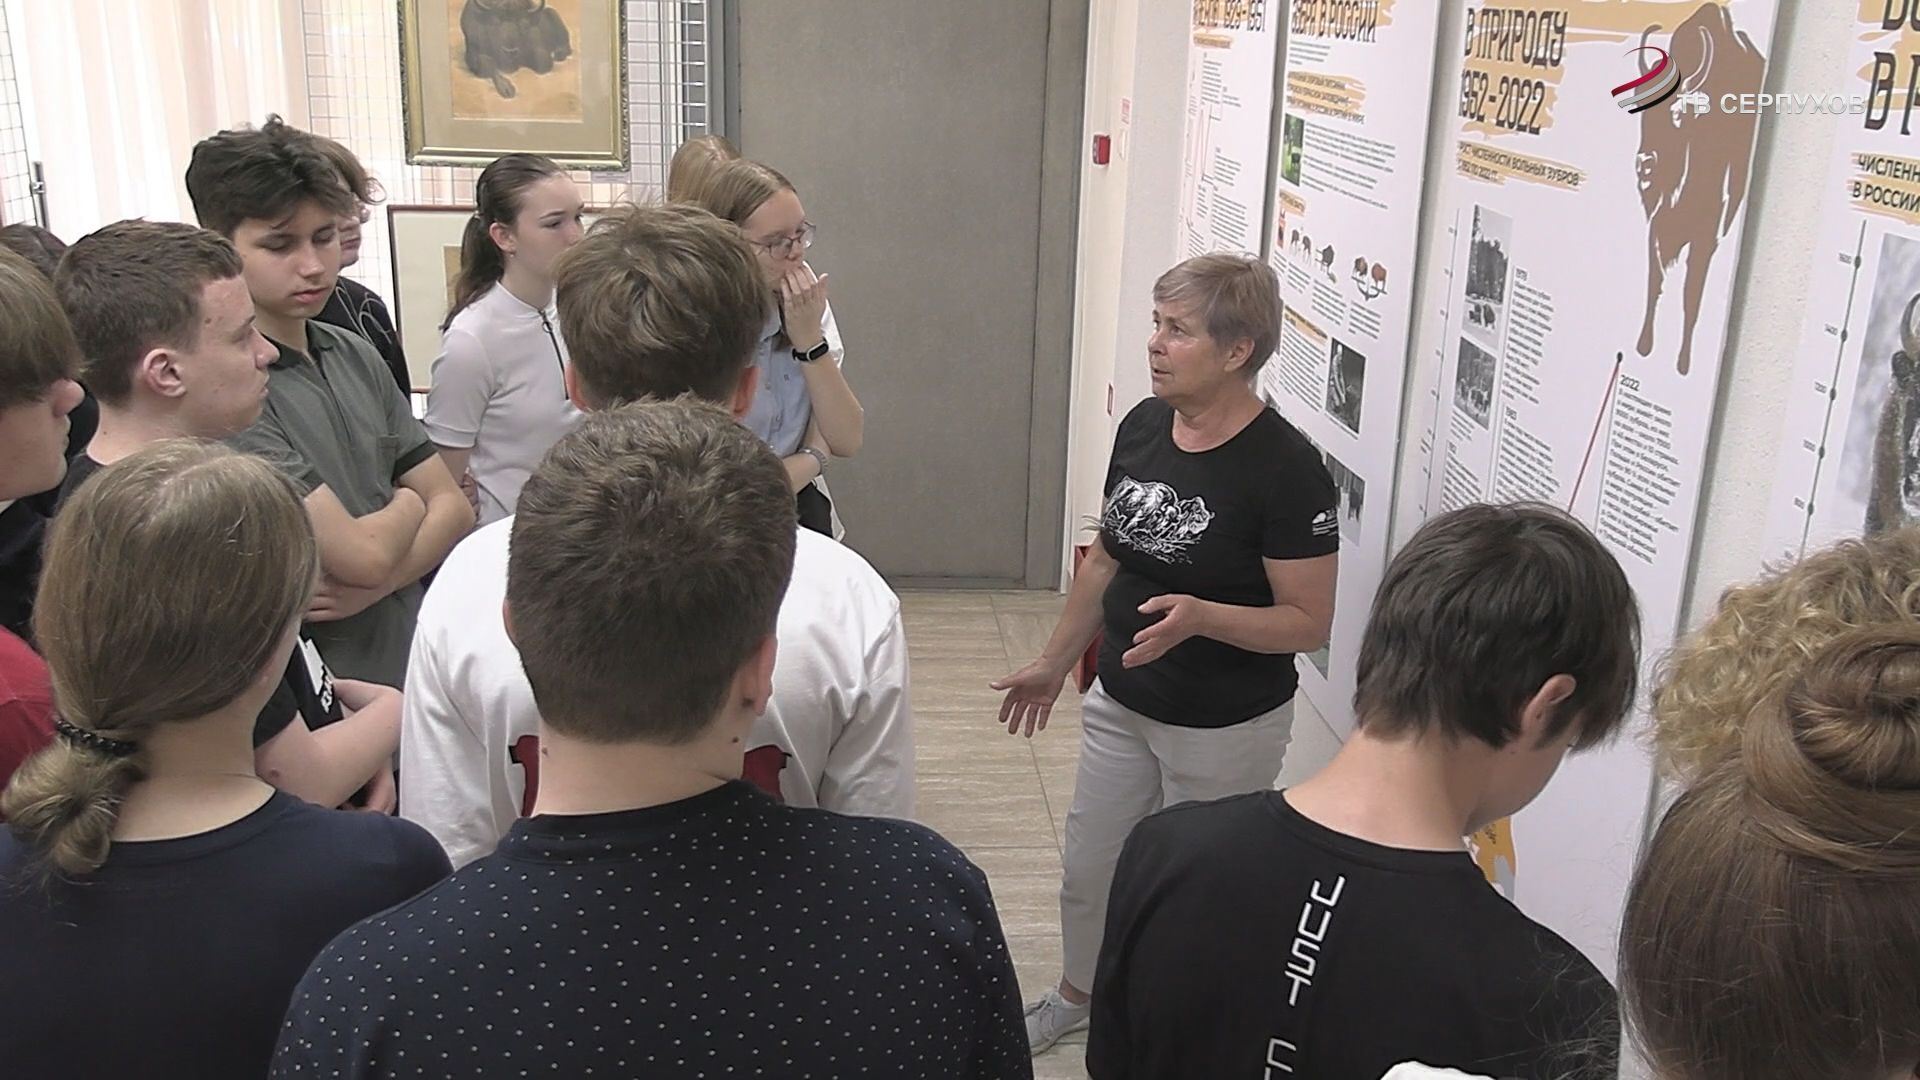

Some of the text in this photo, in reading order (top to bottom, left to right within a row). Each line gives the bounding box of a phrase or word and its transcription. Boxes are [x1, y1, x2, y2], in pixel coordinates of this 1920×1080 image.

[1328, 0, 1378, 43] РОССИИ
[1464, 8, 1568, 70] В ПРИРОДУ
[1864, 51, 1897, 131] В
[1858, 153, 1920, 183] ЧИСЛЕНН
[1852, 181, 1920, 213] В РОССИИ
[1284, 875, 1346, 1007] JUST
[1263, 1037, 1297, 1080] C
